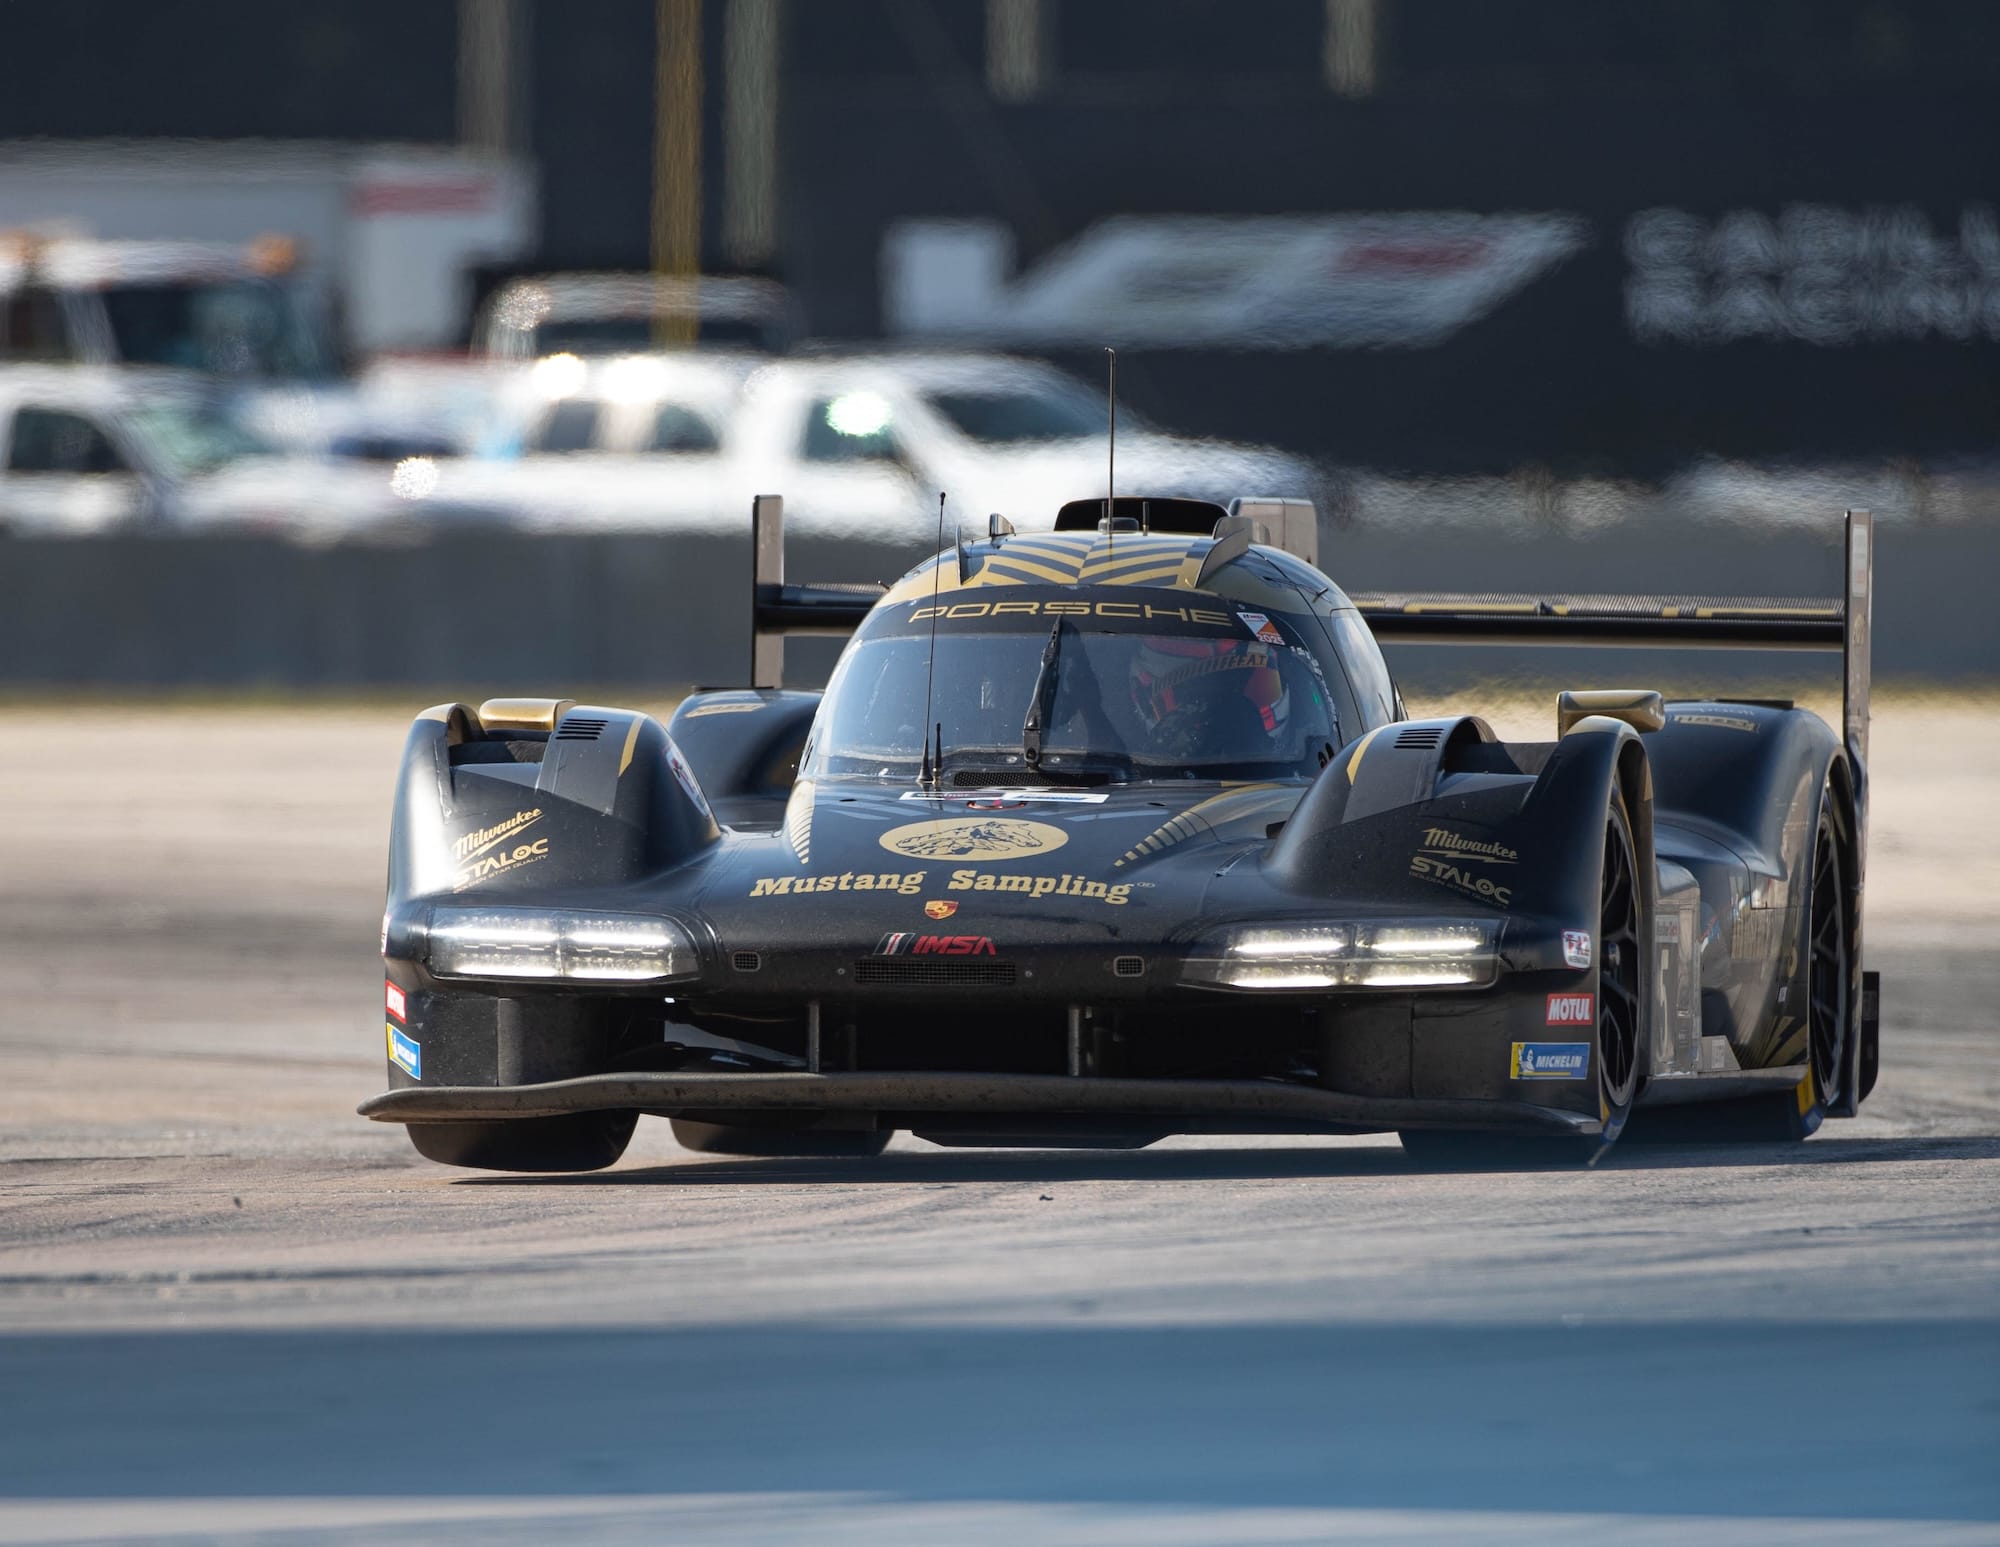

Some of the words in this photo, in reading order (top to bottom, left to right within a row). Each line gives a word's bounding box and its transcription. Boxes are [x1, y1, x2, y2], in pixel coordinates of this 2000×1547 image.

[909, 601, 1233, 627] PORSCHE
[450, 808, 543, 860] Milwaukee
[1421, 827, 1518, 859] Milwaukee
[453, 838, 548, 889] STALOC
[749, 871, 927, 897] Mustang
[947, 869, 1135, 905] Sampling
[1410, 856, 1512, 905] STALOC
[911, 935, 997, 956] IMSA
[1548, 998, 1592, 1021] MOTUL
[1536, 1055, 1582, 1069] MICHELIN
